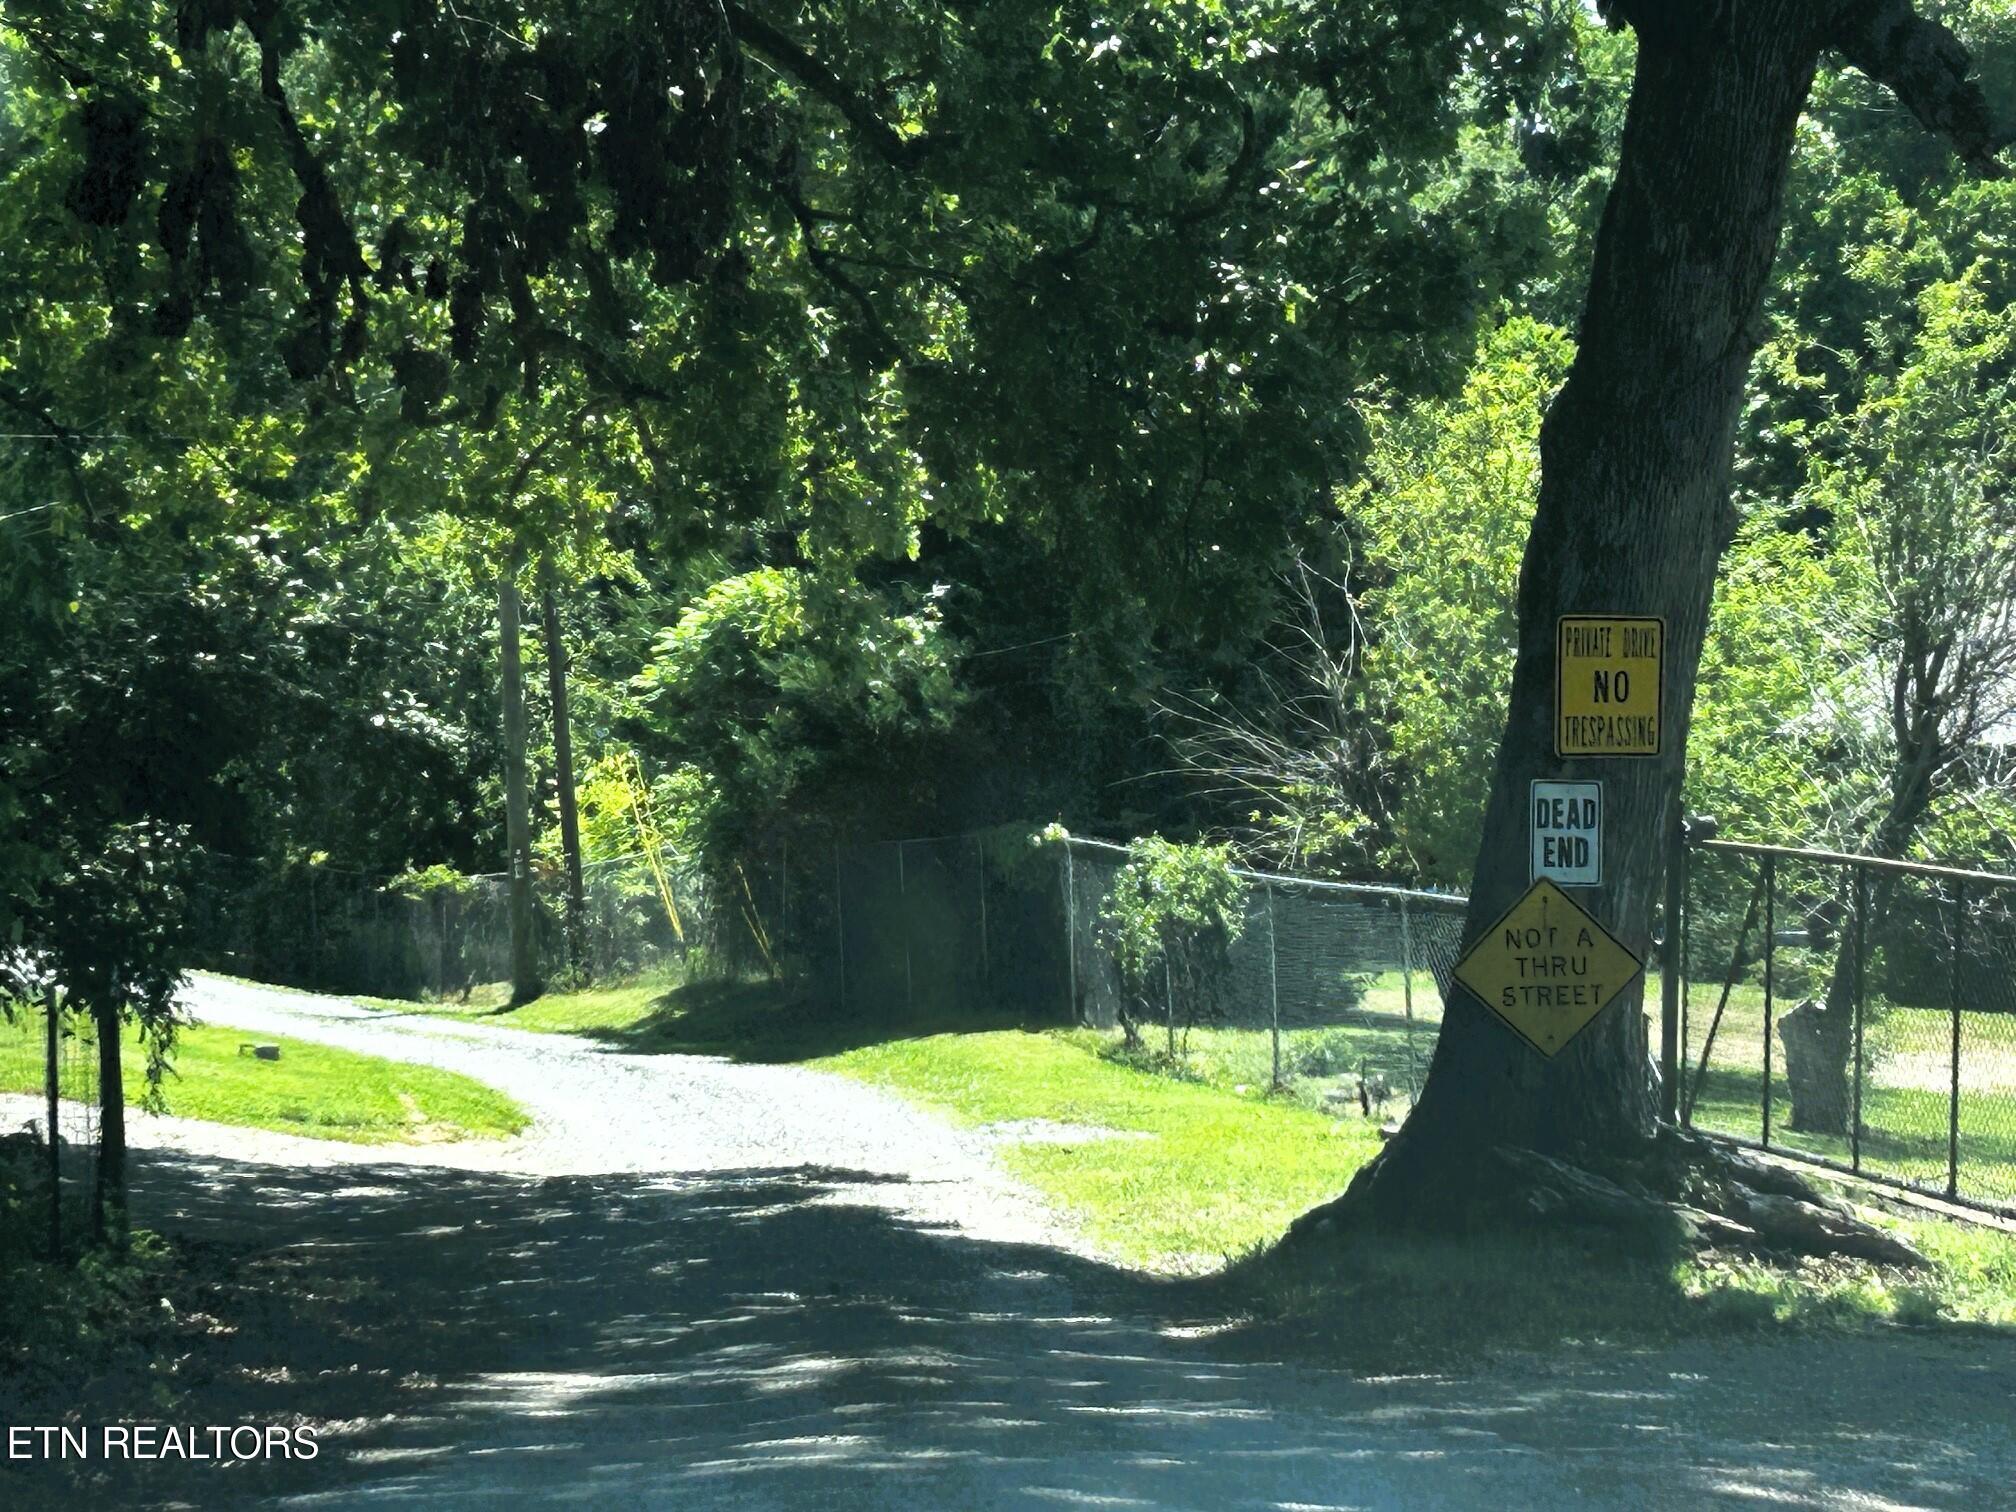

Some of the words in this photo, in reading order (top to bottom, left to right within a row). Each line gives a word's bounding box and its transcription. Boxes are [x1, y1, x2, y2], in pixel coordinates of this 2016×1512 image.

[1594, 670, 1630, 703] NO
[1564, 715, 1656, 748] TRESPASSING
[1536, 798, 1596, 830] DEAD
[1543, 836, 1589, 868] END
[1505, 927, 1558, 949] NOT
[1577, 927, 1594, 948] A
[1514, 956, 1587, 978] THRU
[1502, 984, 1603, 1007] STREET
